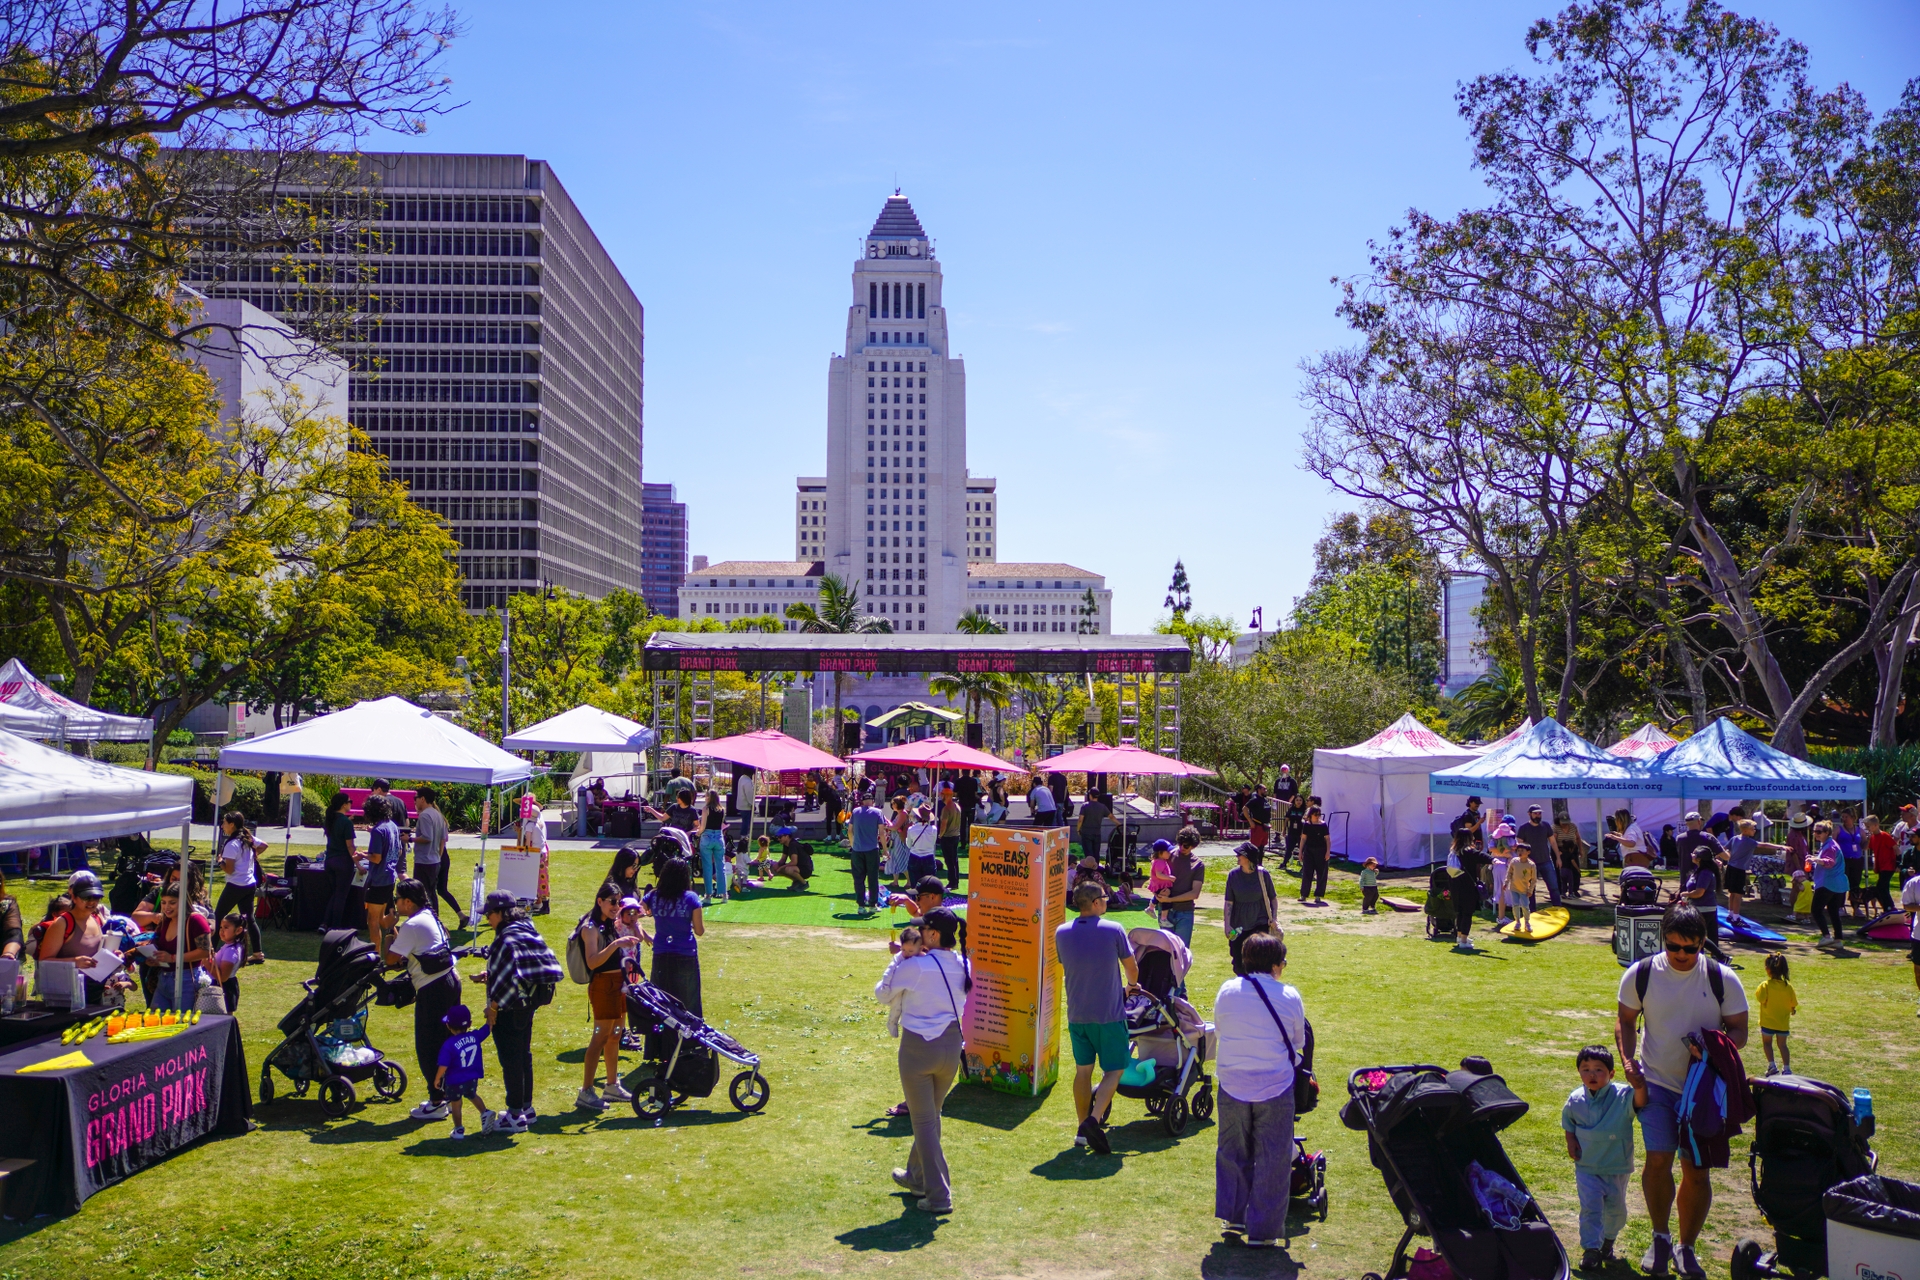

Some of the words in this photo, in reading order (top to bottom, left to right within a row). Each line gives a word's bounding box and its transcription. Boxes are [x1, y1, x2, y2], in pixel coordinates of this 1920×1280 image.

[680, 657, 711, 670] GRAND
[714, 657, 738, 670] PARK
[820, 658, 850, 671] GRAND
[854, 658, 878, 671] PARK
[958, 659, 988, 672] GRAND
[992, 659, 1016, 672] PARK
[1097, 660, 1128, 672] GRAND
[1130, 660, 1155, 672] PARK
[1518, 782, 1662, 792] www.surfbusfoundation.org
[1704, 783, 1847, 793] www.surfbusfoundation.org
[523, 800, 530, 812] 3
[1004, 850, 1030, 865] EASY
[981, 861, 1030, 880] MORNINGS
[454, 1036, 476, 1050] OHTANI
[460, 1044, 477, 1067] 17
[88, 1072, 147, 1112] GLORIA
[154, 1044, 207, 1082] MOLINA
[86, 1093, 155, 1168] GRAND
[162, 1067, 207, 1130] PARK
